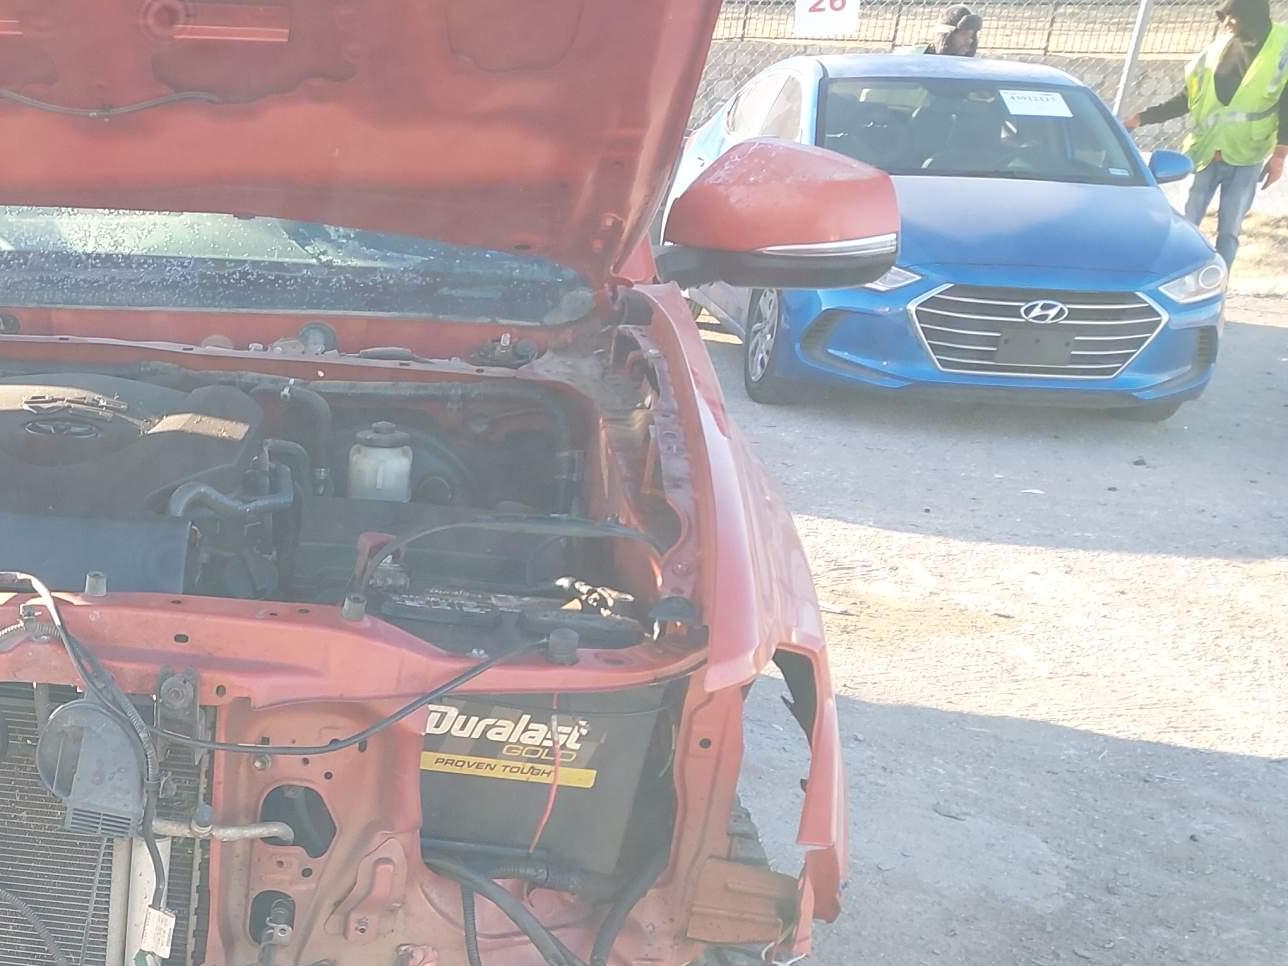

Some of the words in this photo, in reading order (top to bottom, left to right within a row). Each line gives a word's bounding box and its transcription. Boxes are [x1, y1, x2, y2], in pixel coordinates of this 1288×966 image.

[425, 704, 588, 750] Duralast
[502, 744, 577, 761] GOLD
[434, 757, 498, 771] PROVEN
[501, 764, 553, 778] TOUGH
